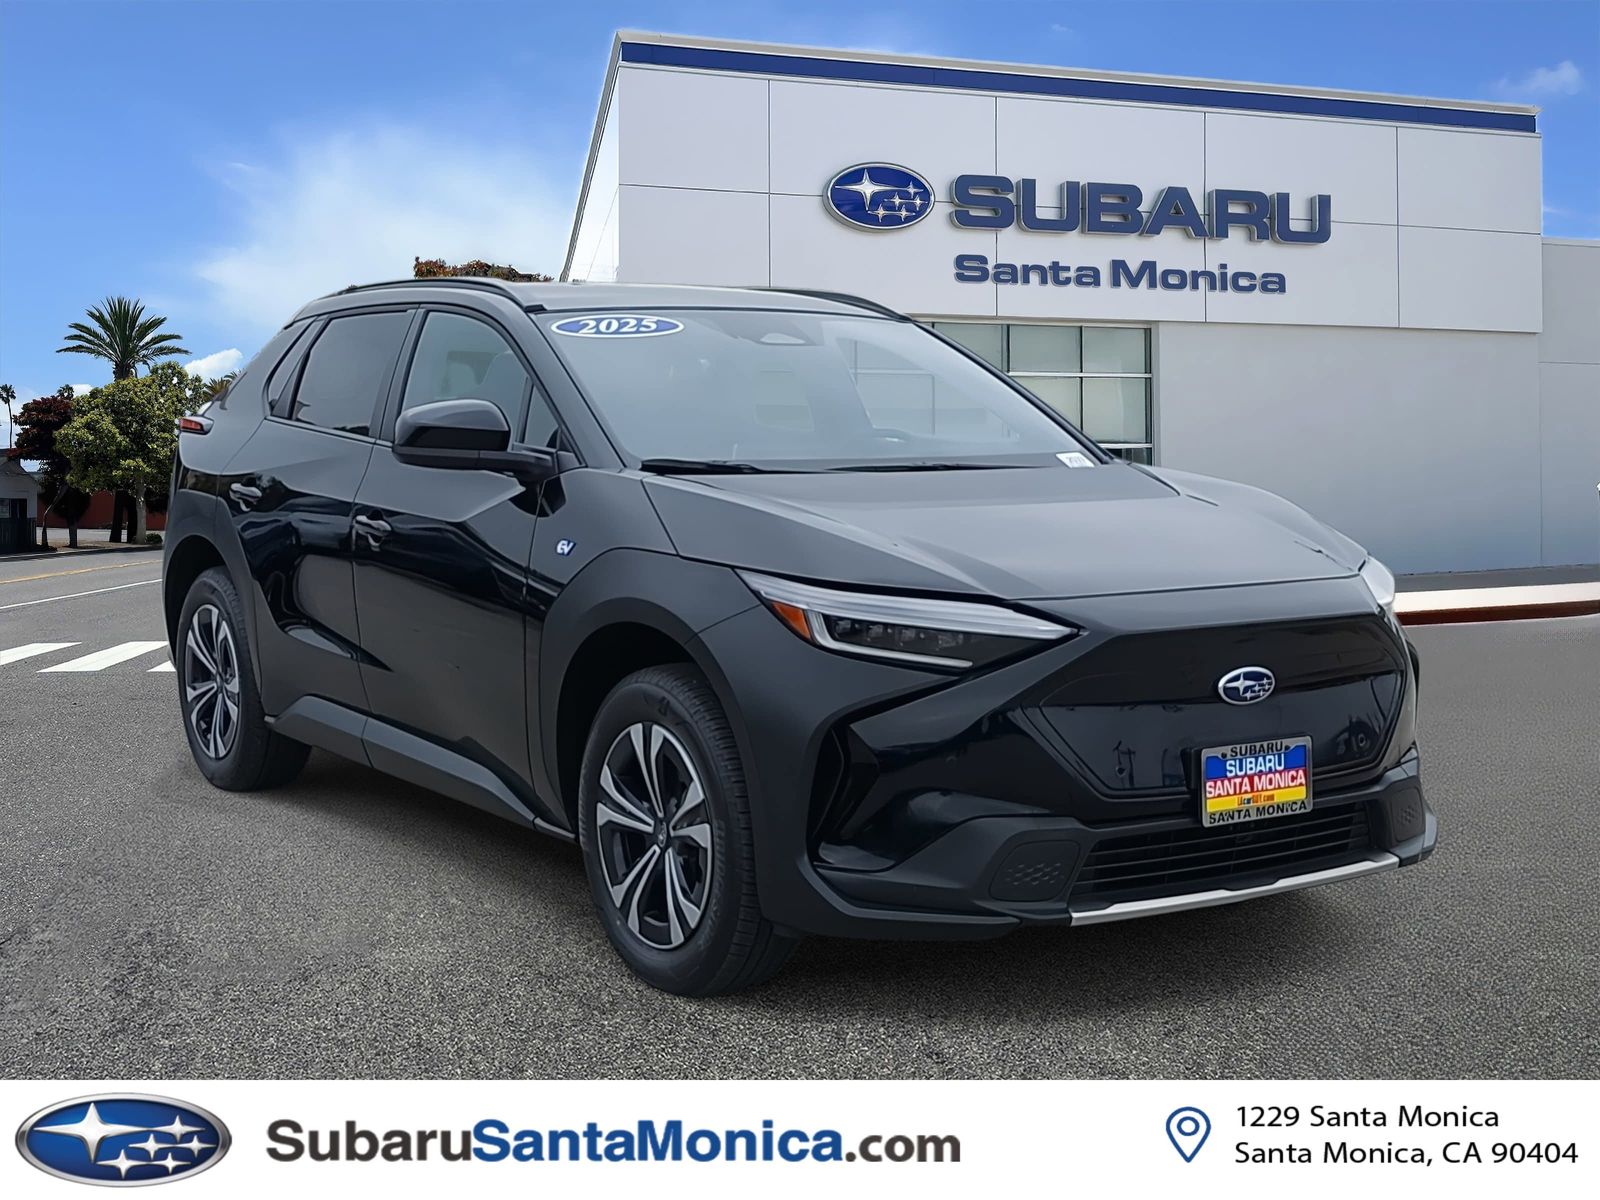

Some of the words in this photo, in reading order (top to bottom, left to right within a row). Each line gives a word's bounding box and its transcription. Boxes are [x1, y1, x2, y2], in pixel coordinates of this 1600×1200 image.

[950, 173, 1332, 244] SUBARU
[954, 254, 1103, 287] Santa
[1110, 258, 1287, 294] Monica
[578, 318, 659, 334] 2025
[1230, 741, 1284, 758] SUBARU
[1226, 753, 1285, 778] SUBARU
[1205, 776, 1251, 798] SANTA
[1253, 769, 1306, 791] MONICA
[1209, 808, 1252, 825] SANTA
[1256, 800, 1308, 818] MONICA
